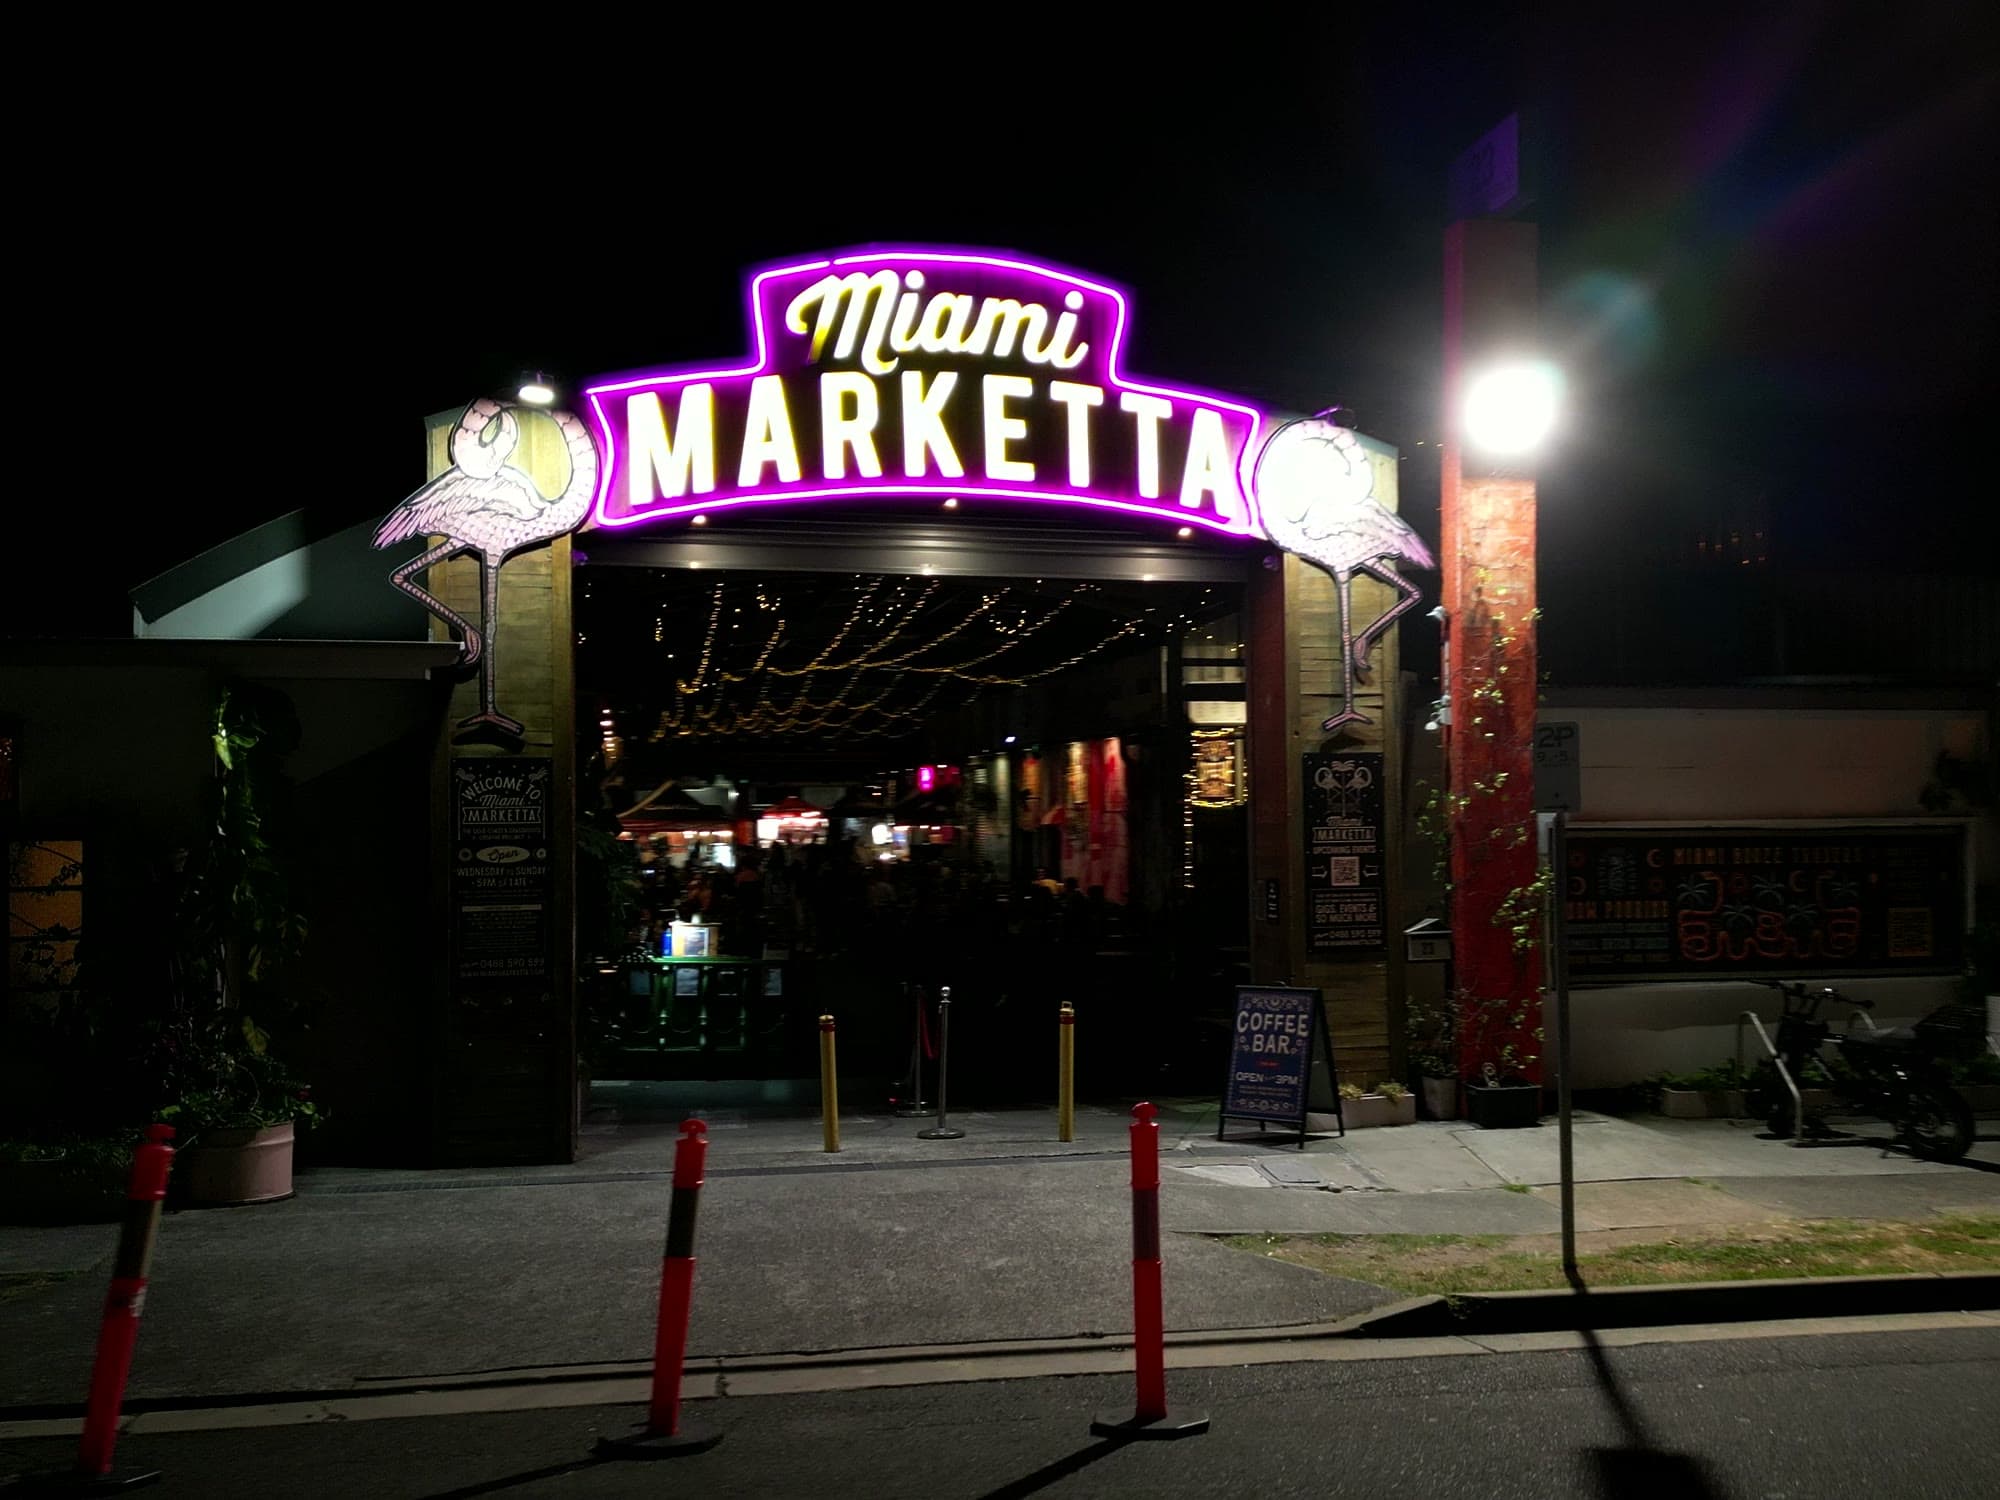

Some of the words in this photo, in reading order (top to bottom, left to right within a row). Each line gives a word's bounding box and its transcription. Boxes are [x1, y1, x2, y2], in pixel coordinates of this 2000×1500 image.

[784, 268, 1089, 377] Miami
[624, 369, 1239, 521] MARKETTA
[1537, 726, 1575, 748] 2P
[461, 776, 525, 800] WELCOME
[525, 783, 542, 800] TO
[479, 794, 526, 808] Miami
[468, 808, 536, 822] MARKETTA
[1316, 828, 1372, 840] MARKETTA
[487, 848, 519, 864] Open
[456, 866, 505, 877] WEDNESDAY
[515, 865, 546, 876] SUNDAY
[475, 877, 497, 887] 5PM
[508, 877, 528, 887] LATE
[1315, 913, 1328, 924] SO
[1236, 1010, 1310, 1038] COFFEE
[1251, 1033, 1291, 1055] BAR
[1235, 1071, 1265, 1083] OPEN
[1274, 1074, 1299, 1085] 3PM
